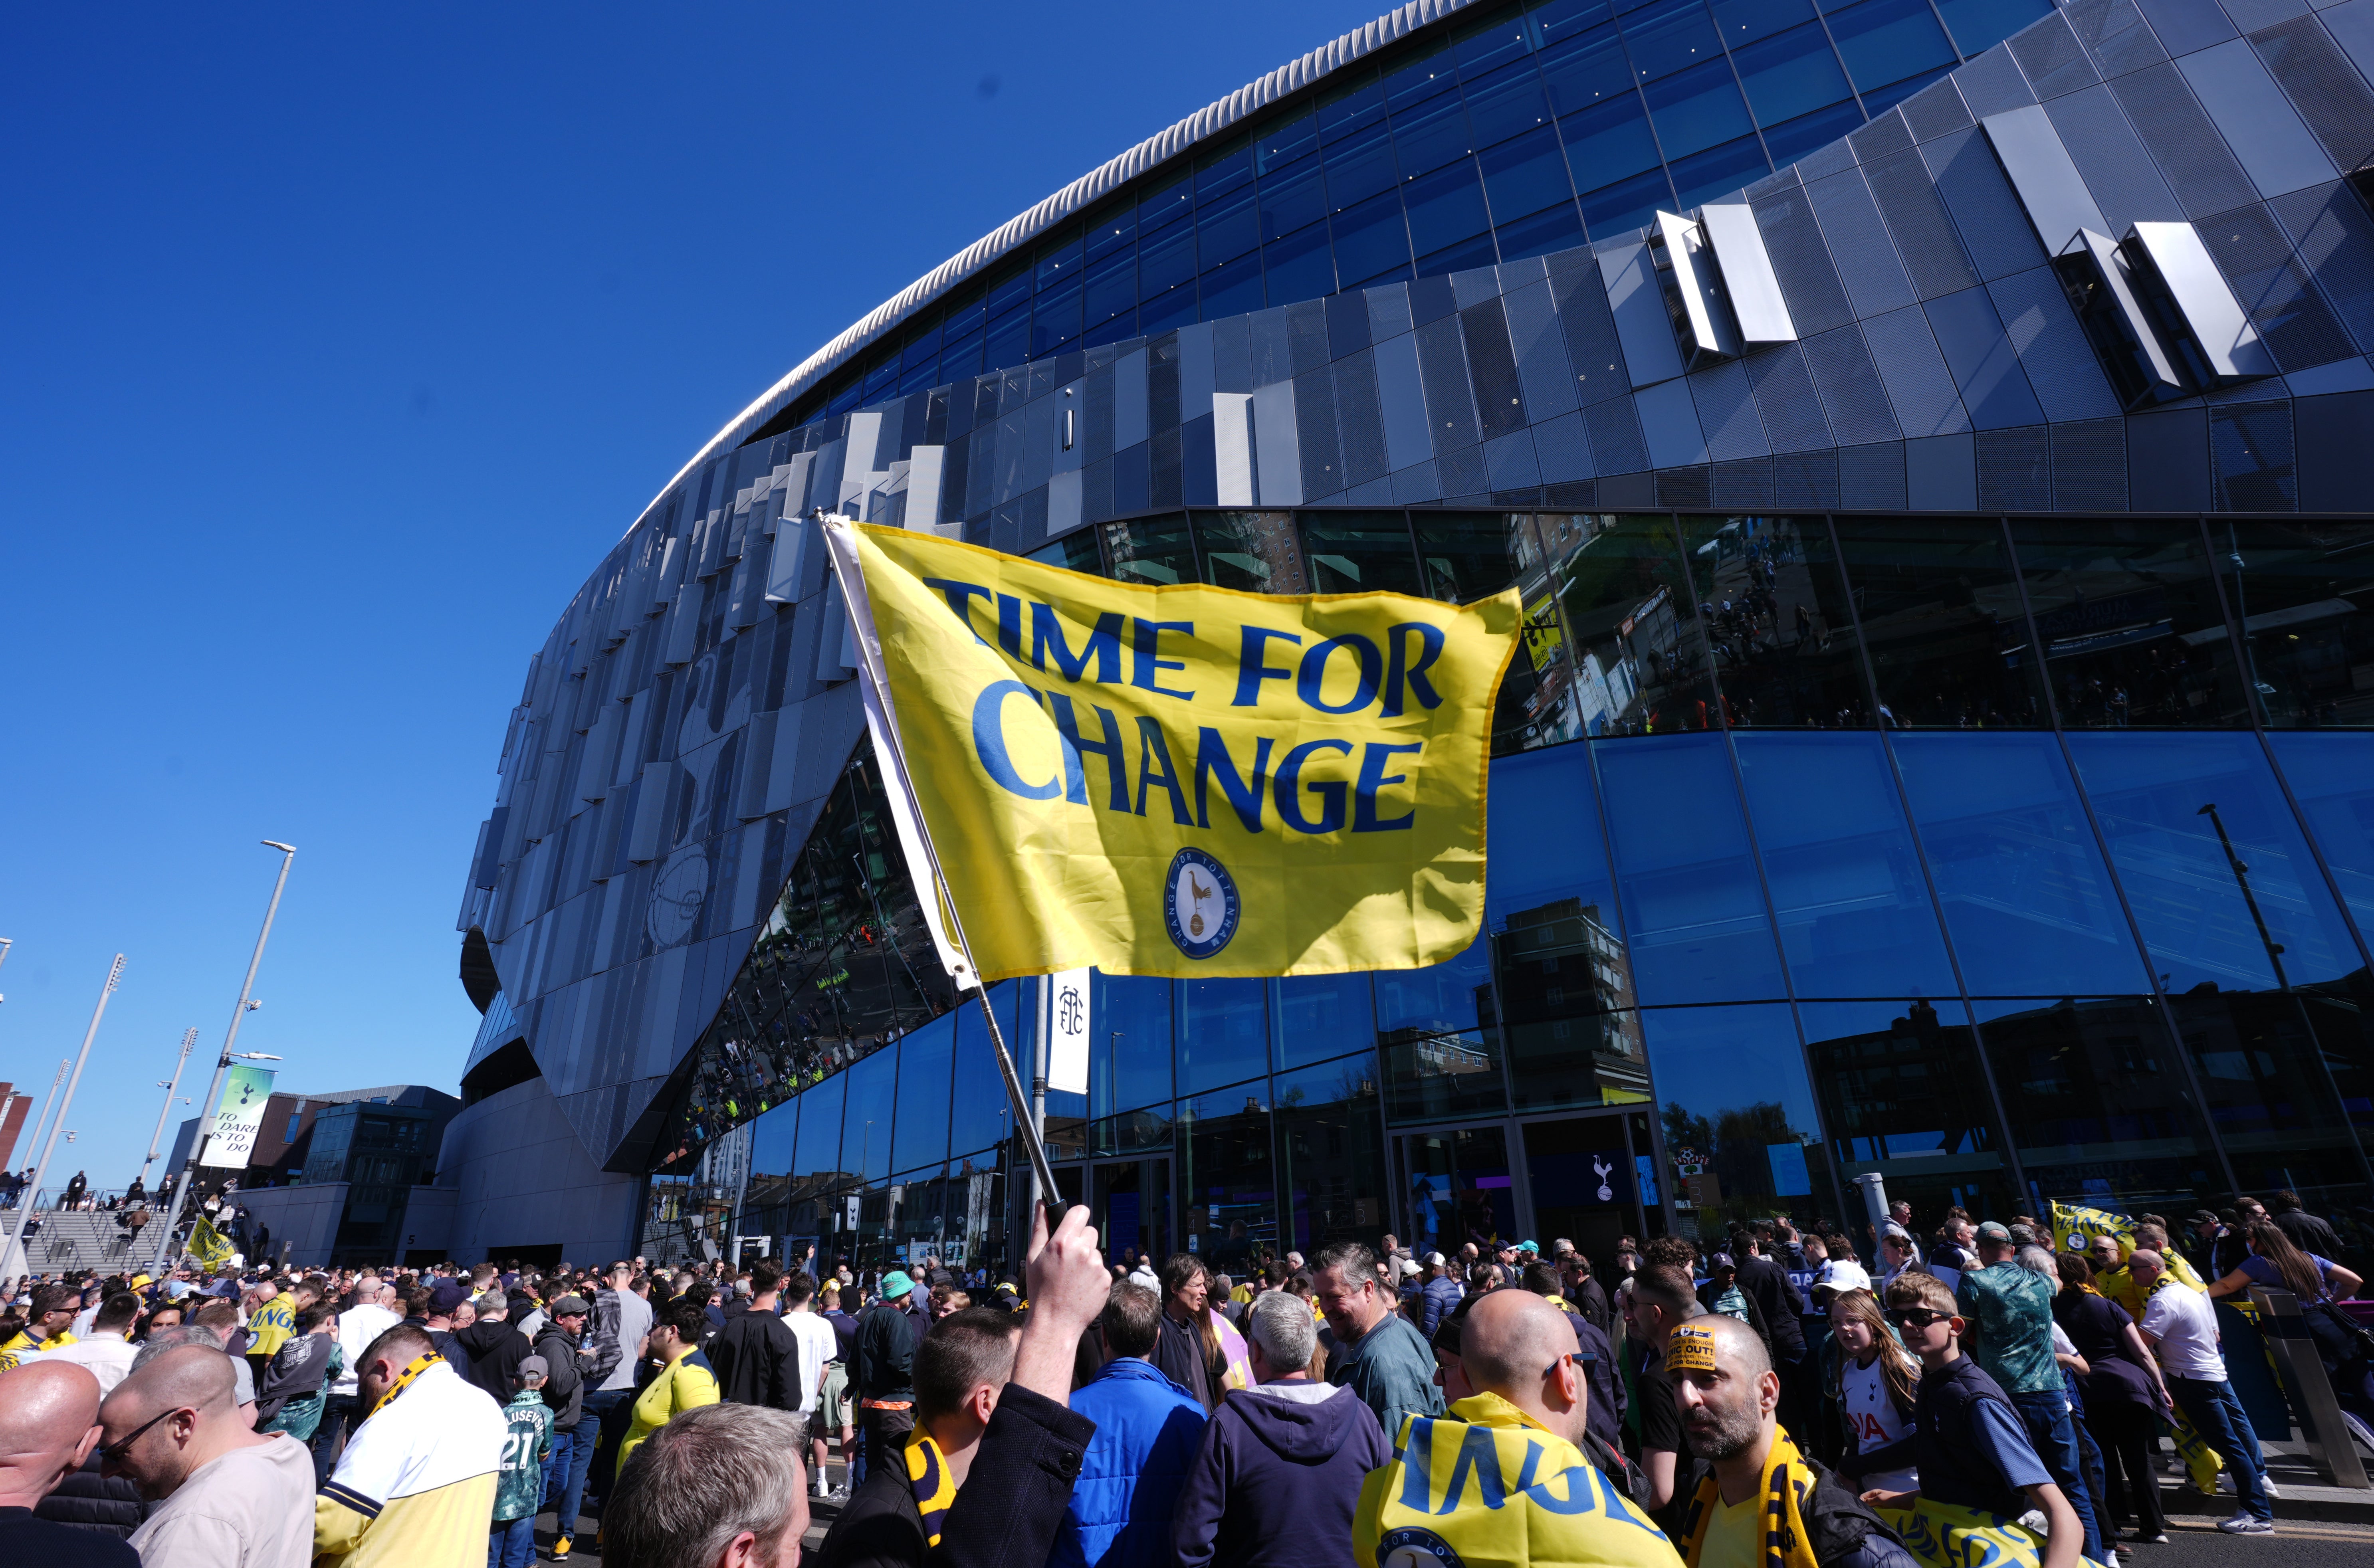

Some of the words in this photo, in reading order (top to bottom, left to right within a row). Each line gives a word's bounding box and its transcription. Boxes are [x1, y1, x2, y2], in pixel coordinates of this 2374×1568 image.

[923, 577, 1195, 701] TIME
[1231, 622, 1445, 718] FOR
[972, 679, 1423, 836] CHANGE
[1176, 853, 1192, 870] FOR
[1203, 857, 1235, 946] TOTTENHAM
[218, 1112, 237, 1121] TO
[220, 1123, 260, 1133] DARE
[209, 1131, 224, 1140] IS
[227, 1133, 246, 1142] TO
[226, 1143, 249, 1152] DO
[1690, 1186, 1702, 1204] 3
[1357, 1209, 1365, 1224] 3
[1189, 1219, 1196, 1232] 4
[407, 1235, 416, 1245] 5
[990, 1229, 995, 1241] 4
[210, 1235, 231, 1252] FOR
[1686, 1345, 1713, 1356] OUT!
[505, 1410, 544, 1437] LUSEVSKI
[500, 1433, 534, 1470] 21
[1383, 1532, 1410, 1551] FOR
[1427, 1538, 1455, 1566] TOT
